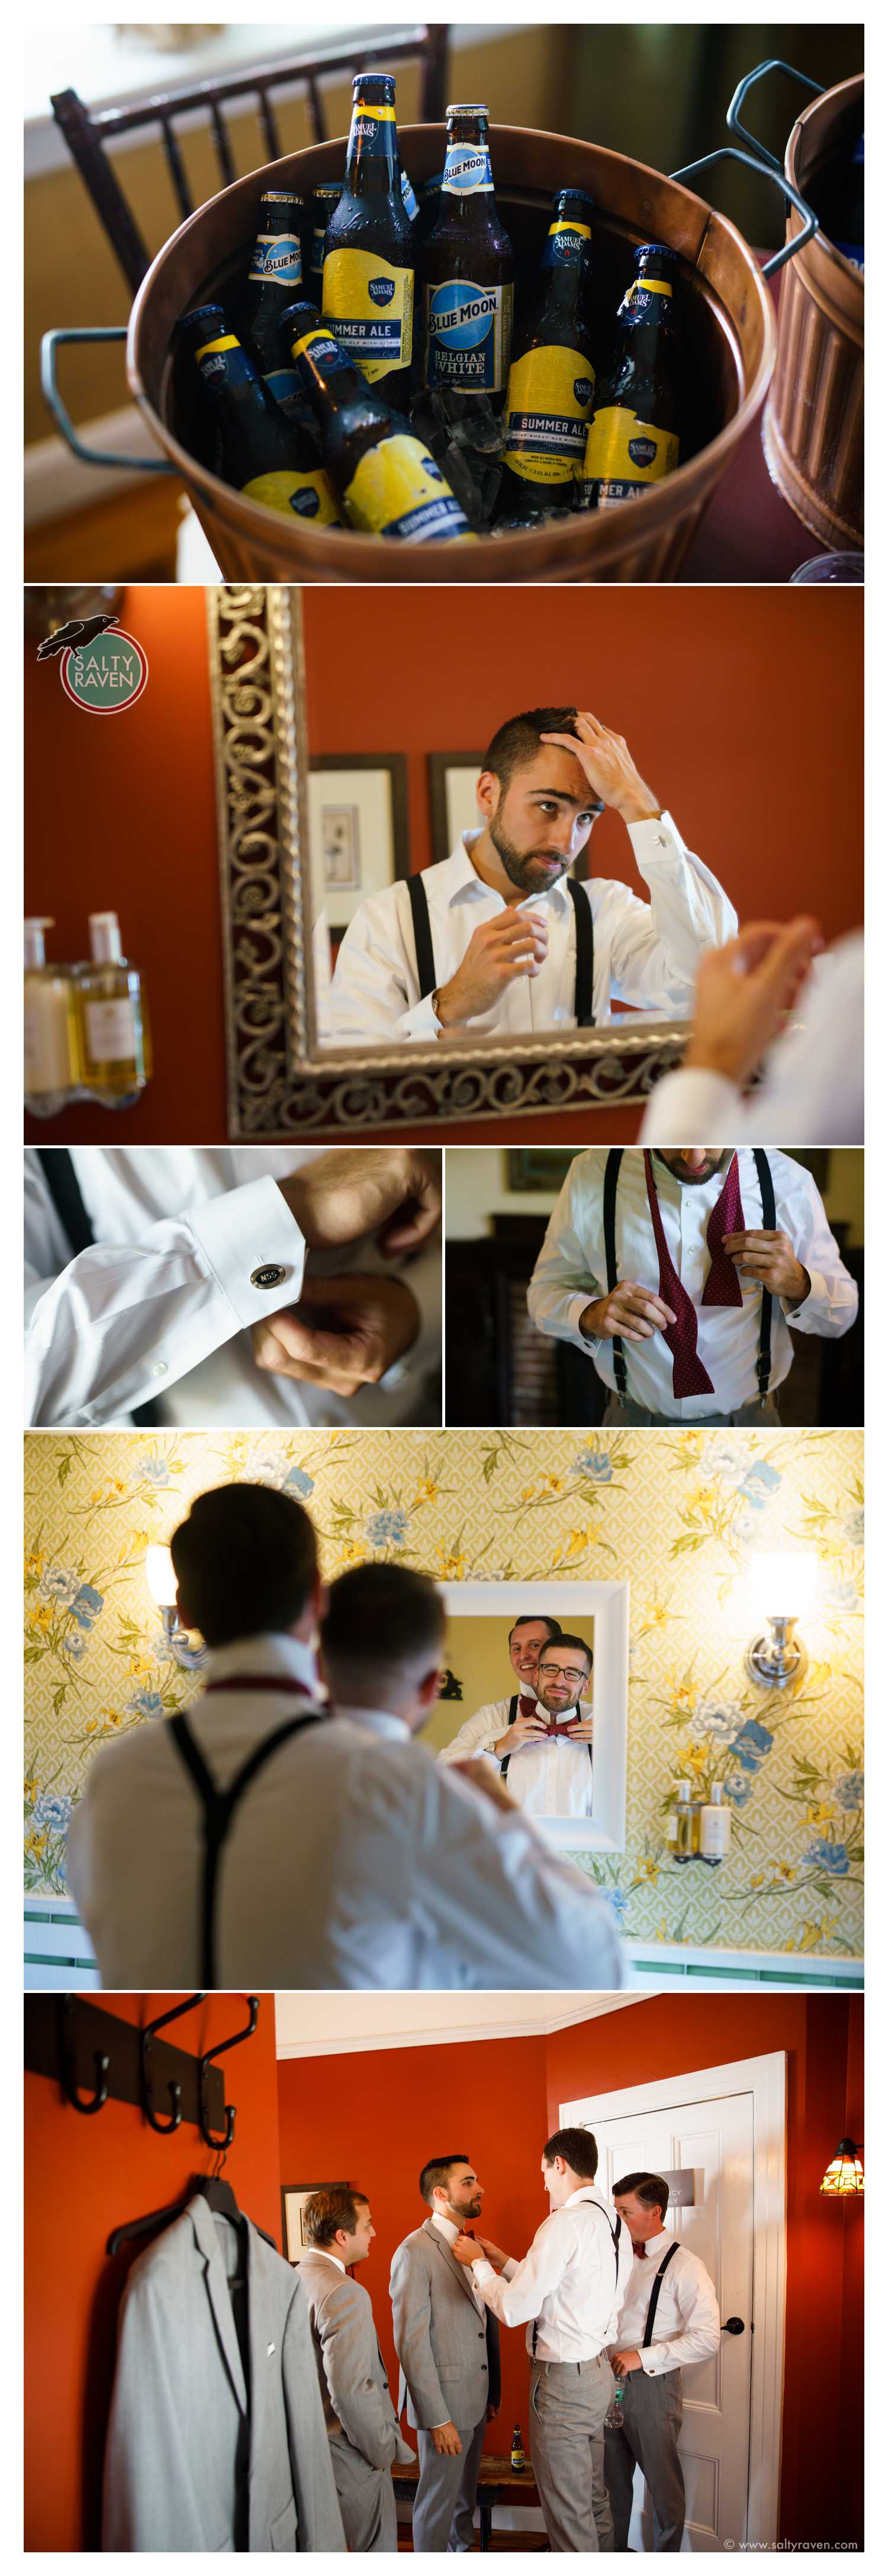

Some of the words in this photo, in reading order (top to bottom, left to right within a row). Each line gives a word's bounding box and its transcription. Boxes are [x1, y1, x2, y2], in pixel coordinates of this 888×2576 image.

[444, 165, 462, 182] BLUE
[463, 157, 486, 172] MOON
[555, 235, 583, 246] SAMUEL
[556, 242, 581, 250] ADAMS
[264, 257, 289, 273] BLUE
[370, 283, 394, 291] SAMUEL
[427, 312, 458, 334] BLUE
[460, 297, 498, 323] MOON
[370, 325, 391, 336] ALE
[435, 350, 486, 363] BELGIAN
[435, 359, 485, 374] WHITE
[522, 418, 568, 433] SUMMER
[572, 424, 587, 436] ALE
[584, 484, 623, 497] SUMER
[260, 1271, 277, 1282] NSS
